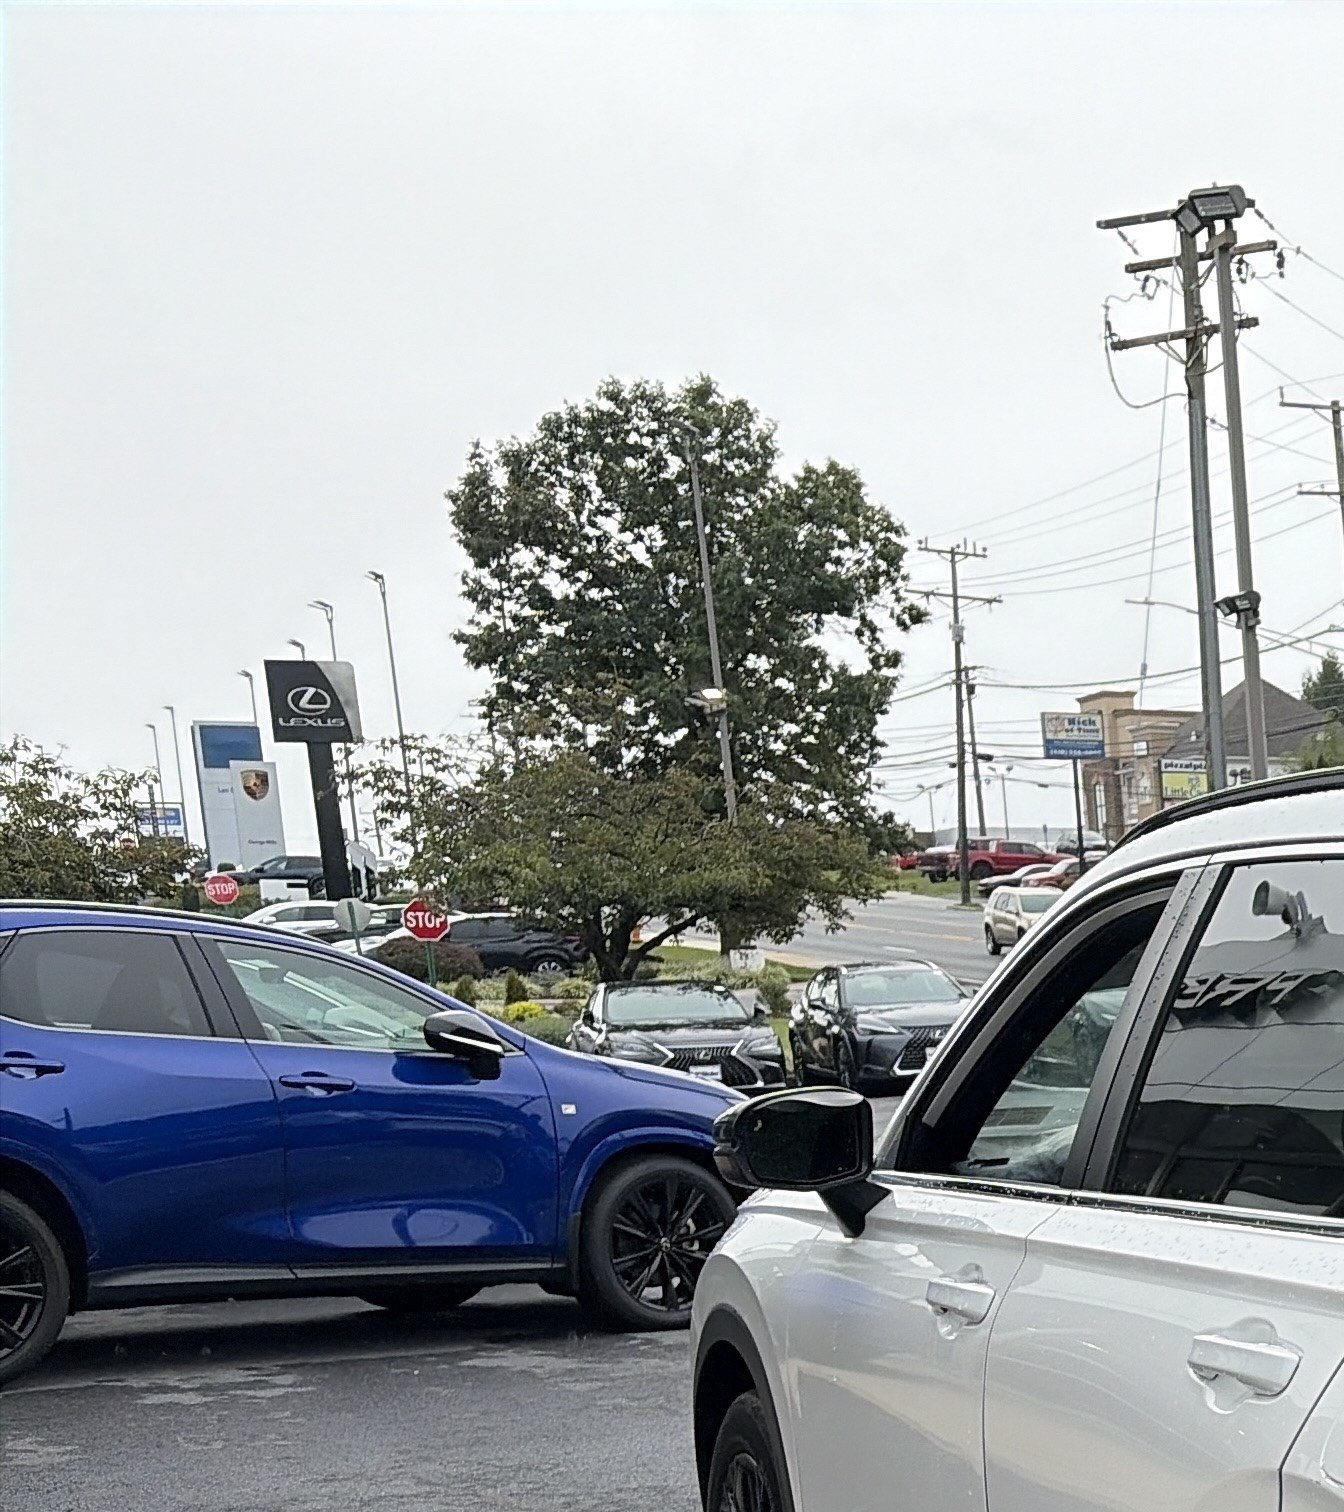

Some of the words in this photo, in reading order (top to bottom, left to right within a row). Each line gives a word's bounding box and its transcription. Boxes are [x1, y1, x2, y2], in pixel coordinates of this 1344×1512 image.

[278, 716, 346, 727] LEXUS
[207, 882, 237, 896] STOP
[406, 910, 448, 929] STOP
